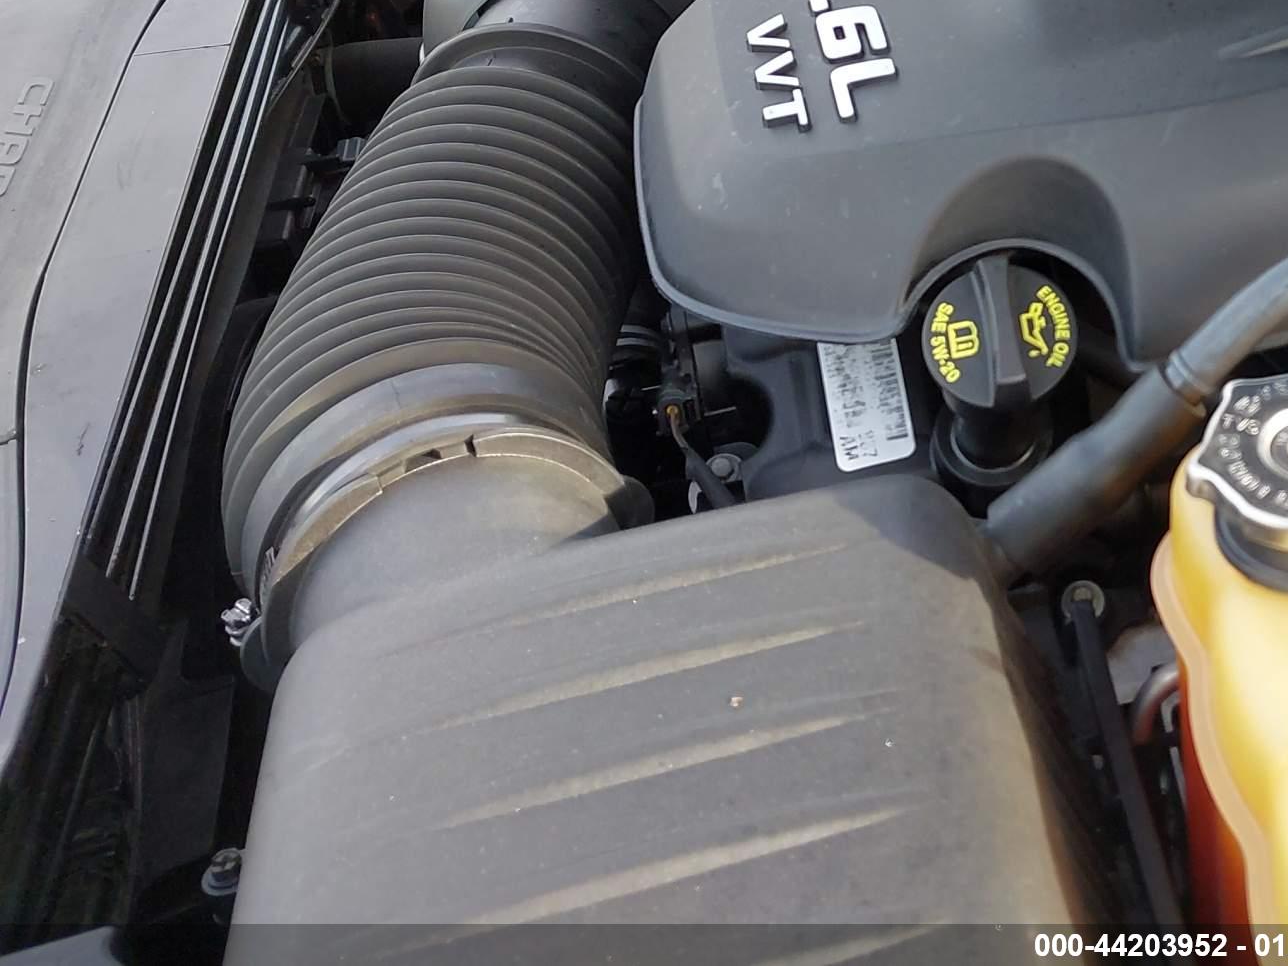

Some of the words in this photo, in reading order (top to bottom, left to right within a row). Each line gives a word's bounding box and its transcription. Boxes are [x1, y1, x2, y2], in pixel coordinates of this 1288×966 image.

[746, 13, 810, 128] VVT
[930, 302, 954, 333] SAE
[1036, 285, 1071, 341] ENGINE
[929, 336, 961, 383] 5W-20
[1045, 342, 1069, 368] OIL
